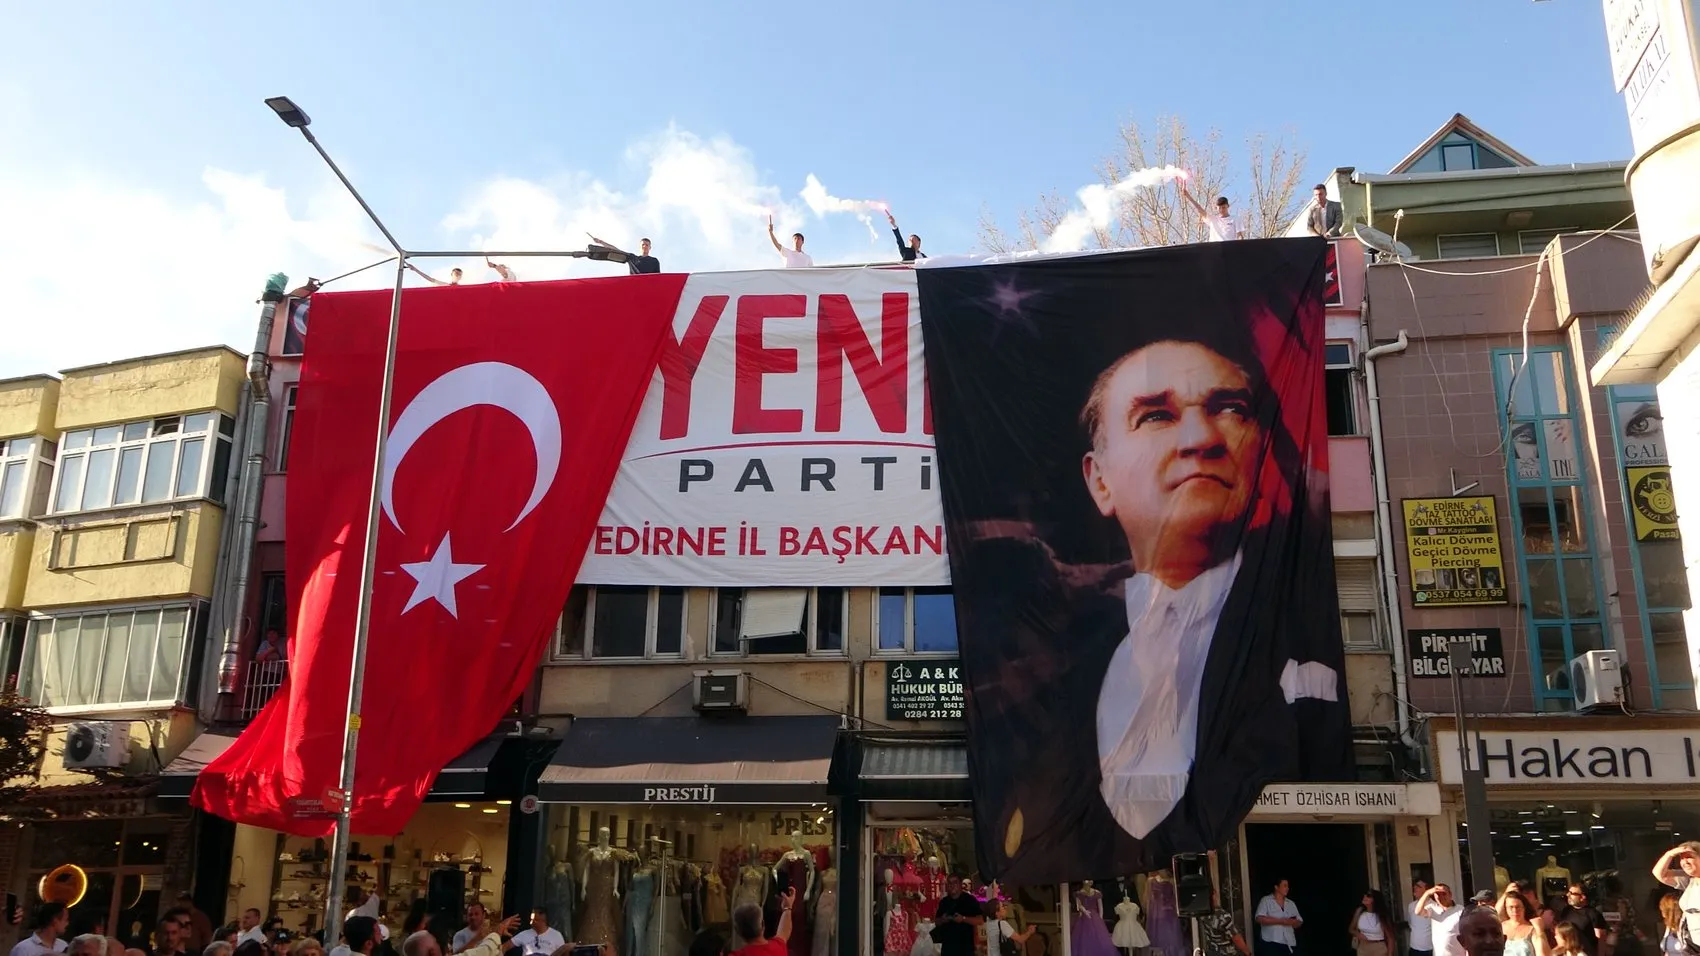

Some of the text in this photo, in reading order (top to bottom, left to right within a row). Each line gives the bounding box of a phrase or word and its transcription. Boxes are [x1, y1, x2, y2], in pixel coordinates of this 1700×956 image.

[1433, 500, 1466, 511] EDİRNE
[1425, 509, 1477, 519] TAZ TATTOO
[1409, 516, 1493, 527] DÖVME SANATLARI
[594, 520, 727, 556] EDİRNE
[738, 520, 767, 556] İL
[1653, 530, 1680, 539] Pasaj
[1413, 536, 1494, 546] Kalıcı Dövme
[1412, 546, 1497, 558] Geçici Dövme
[1431, 557, 1481, 567] Piercing
[1426, 589, 1503, 599] 0537 054 69 99
[1412, 655, 1504, 675] BİLGİYAR
[920, 667, 959, 679] A & K
[891, 681, 963, 694] HUKUK BÜR
[904, 710, 962, 718] 0284 212 28
[1480, 738, 1653, 778] Hakan
[644, 784, 716, 804] PRESTİJ
[1296, 790, 1351, 806] ÖZHİSAR
